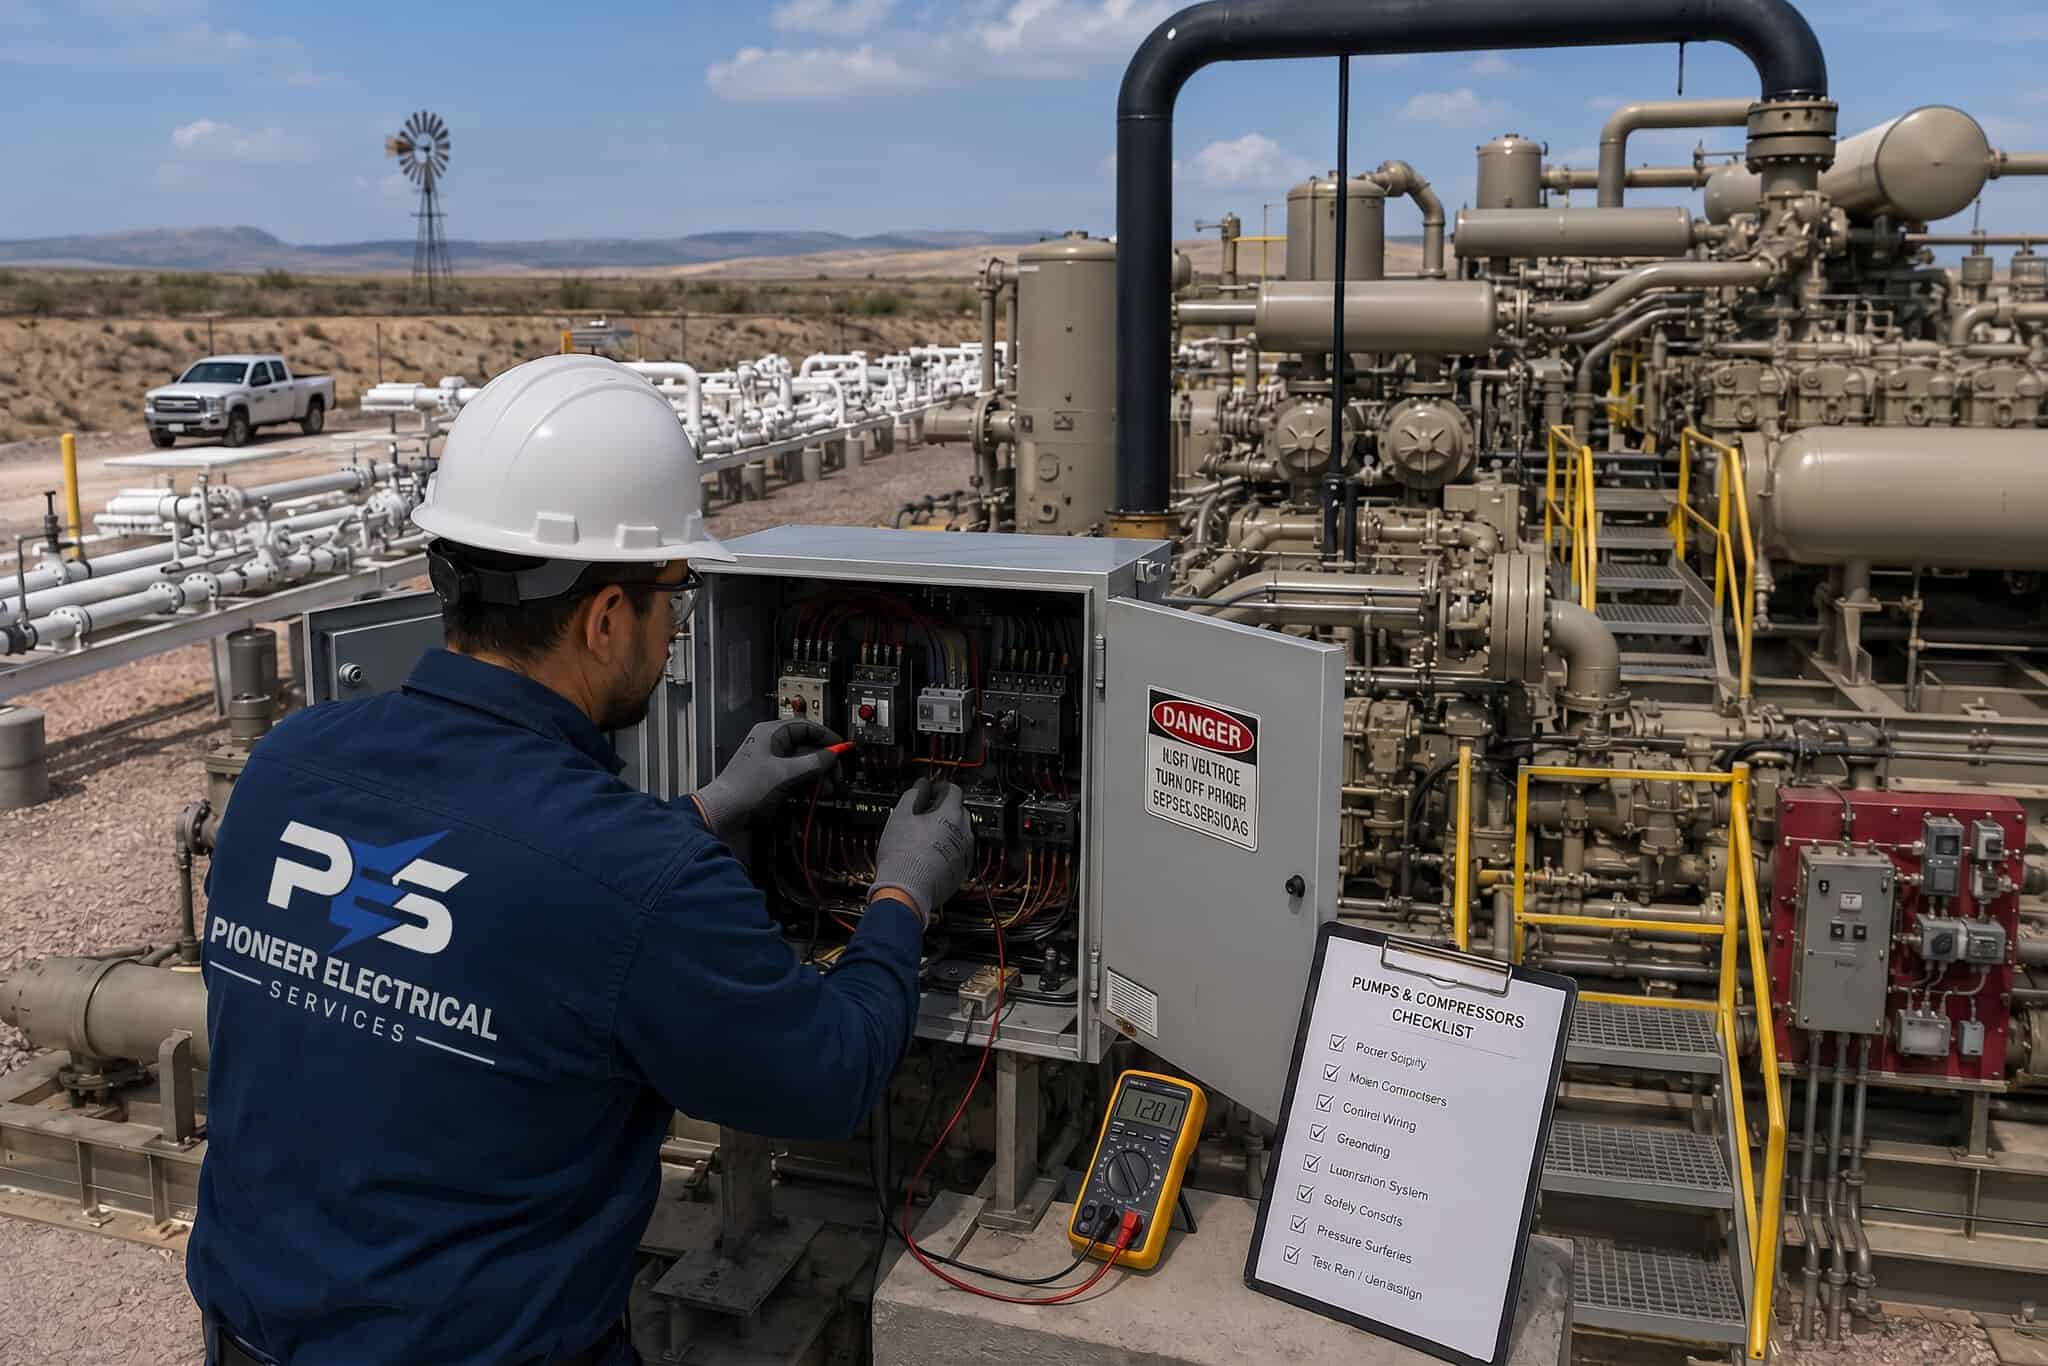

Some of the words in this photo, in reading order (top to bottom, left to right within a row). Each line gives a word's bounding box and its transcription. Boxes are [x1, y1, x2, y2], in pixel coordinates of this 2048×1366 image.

[1162, 705, 1241, 748] DANGER
[1155, 768, 1182, 790] TURN
[1185, 778, 1205, 797] OFF
[210, 916, 319, 980] PIONEER
[323, 956, 498, 1041] ELECTRICAL
[269, 980, 405, 1042] SERVICES
[1352, 976, 1399, 998] PUMPS
[1402, 988, 1413, 1002] &
[1417, 992, 1525, 1029] COMPRESSORS
[1392, 1009, 1474, 1040] CHECKLIST
[1317, 1225, 1362, 1248] Pressure
